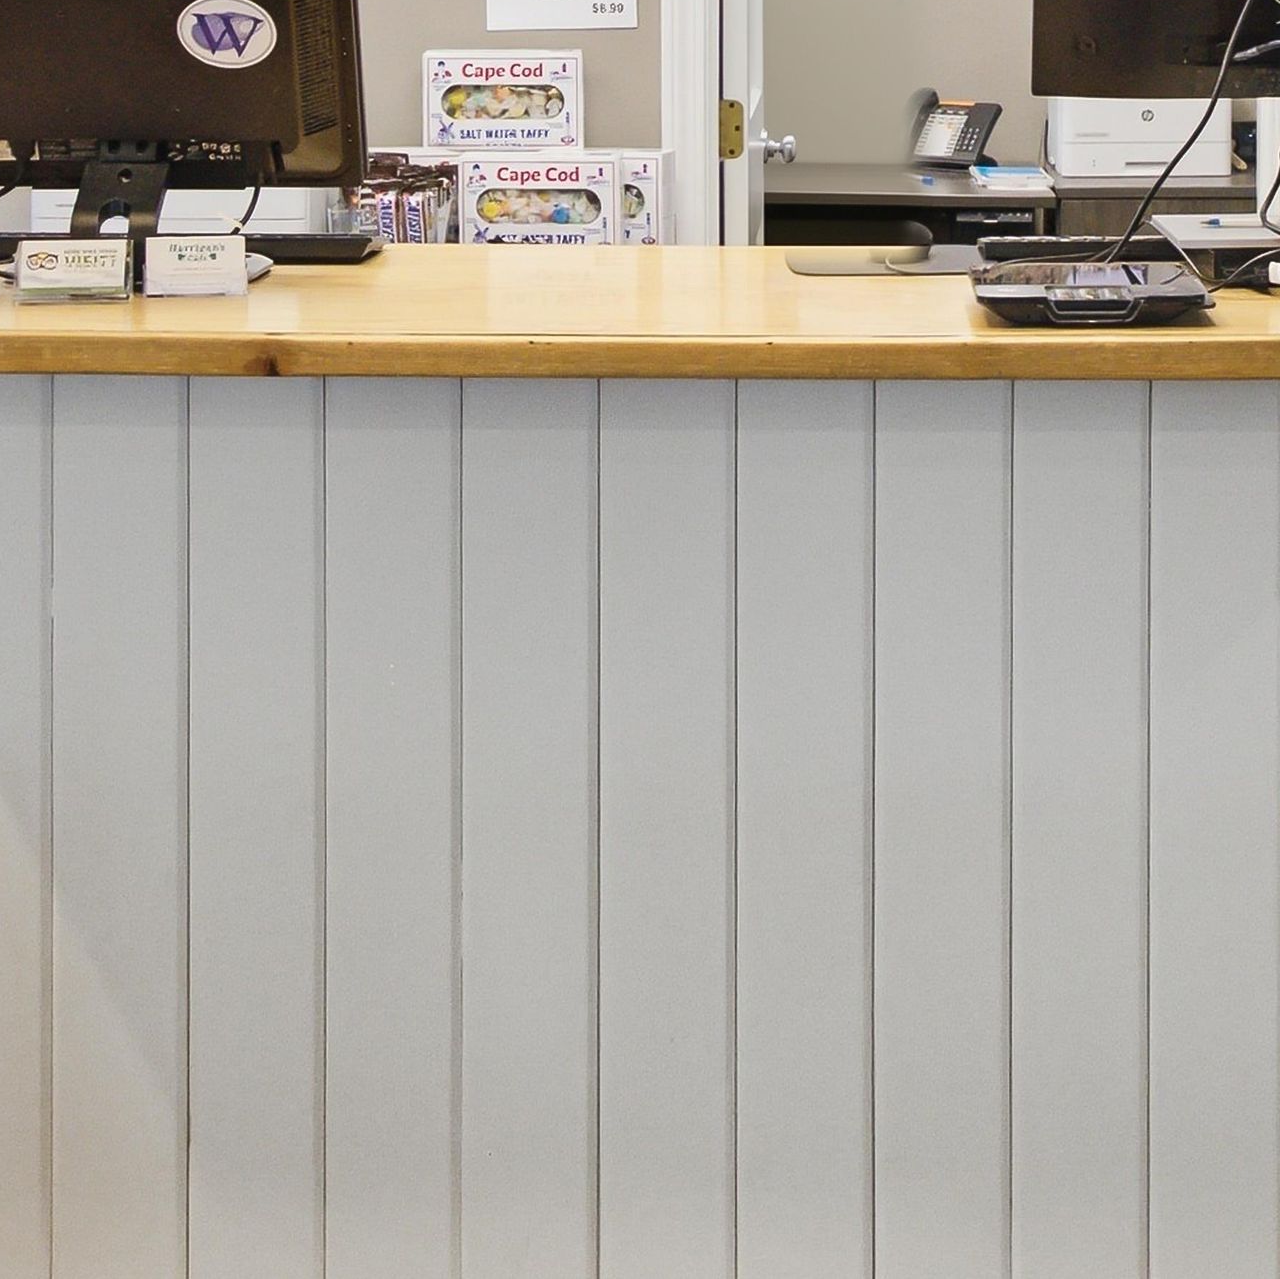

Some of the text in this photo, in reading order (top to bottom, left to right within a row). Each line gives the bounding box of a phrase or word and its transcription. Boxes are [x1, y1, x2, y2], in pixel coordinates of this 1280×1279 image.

[191, 12, 264, 58] W
[462, 62, 543, 82] Cape Cod
[460, 128, 551, 140] SALT WATER TAFFY
[497, 166, 580, 185] Cape Cod
